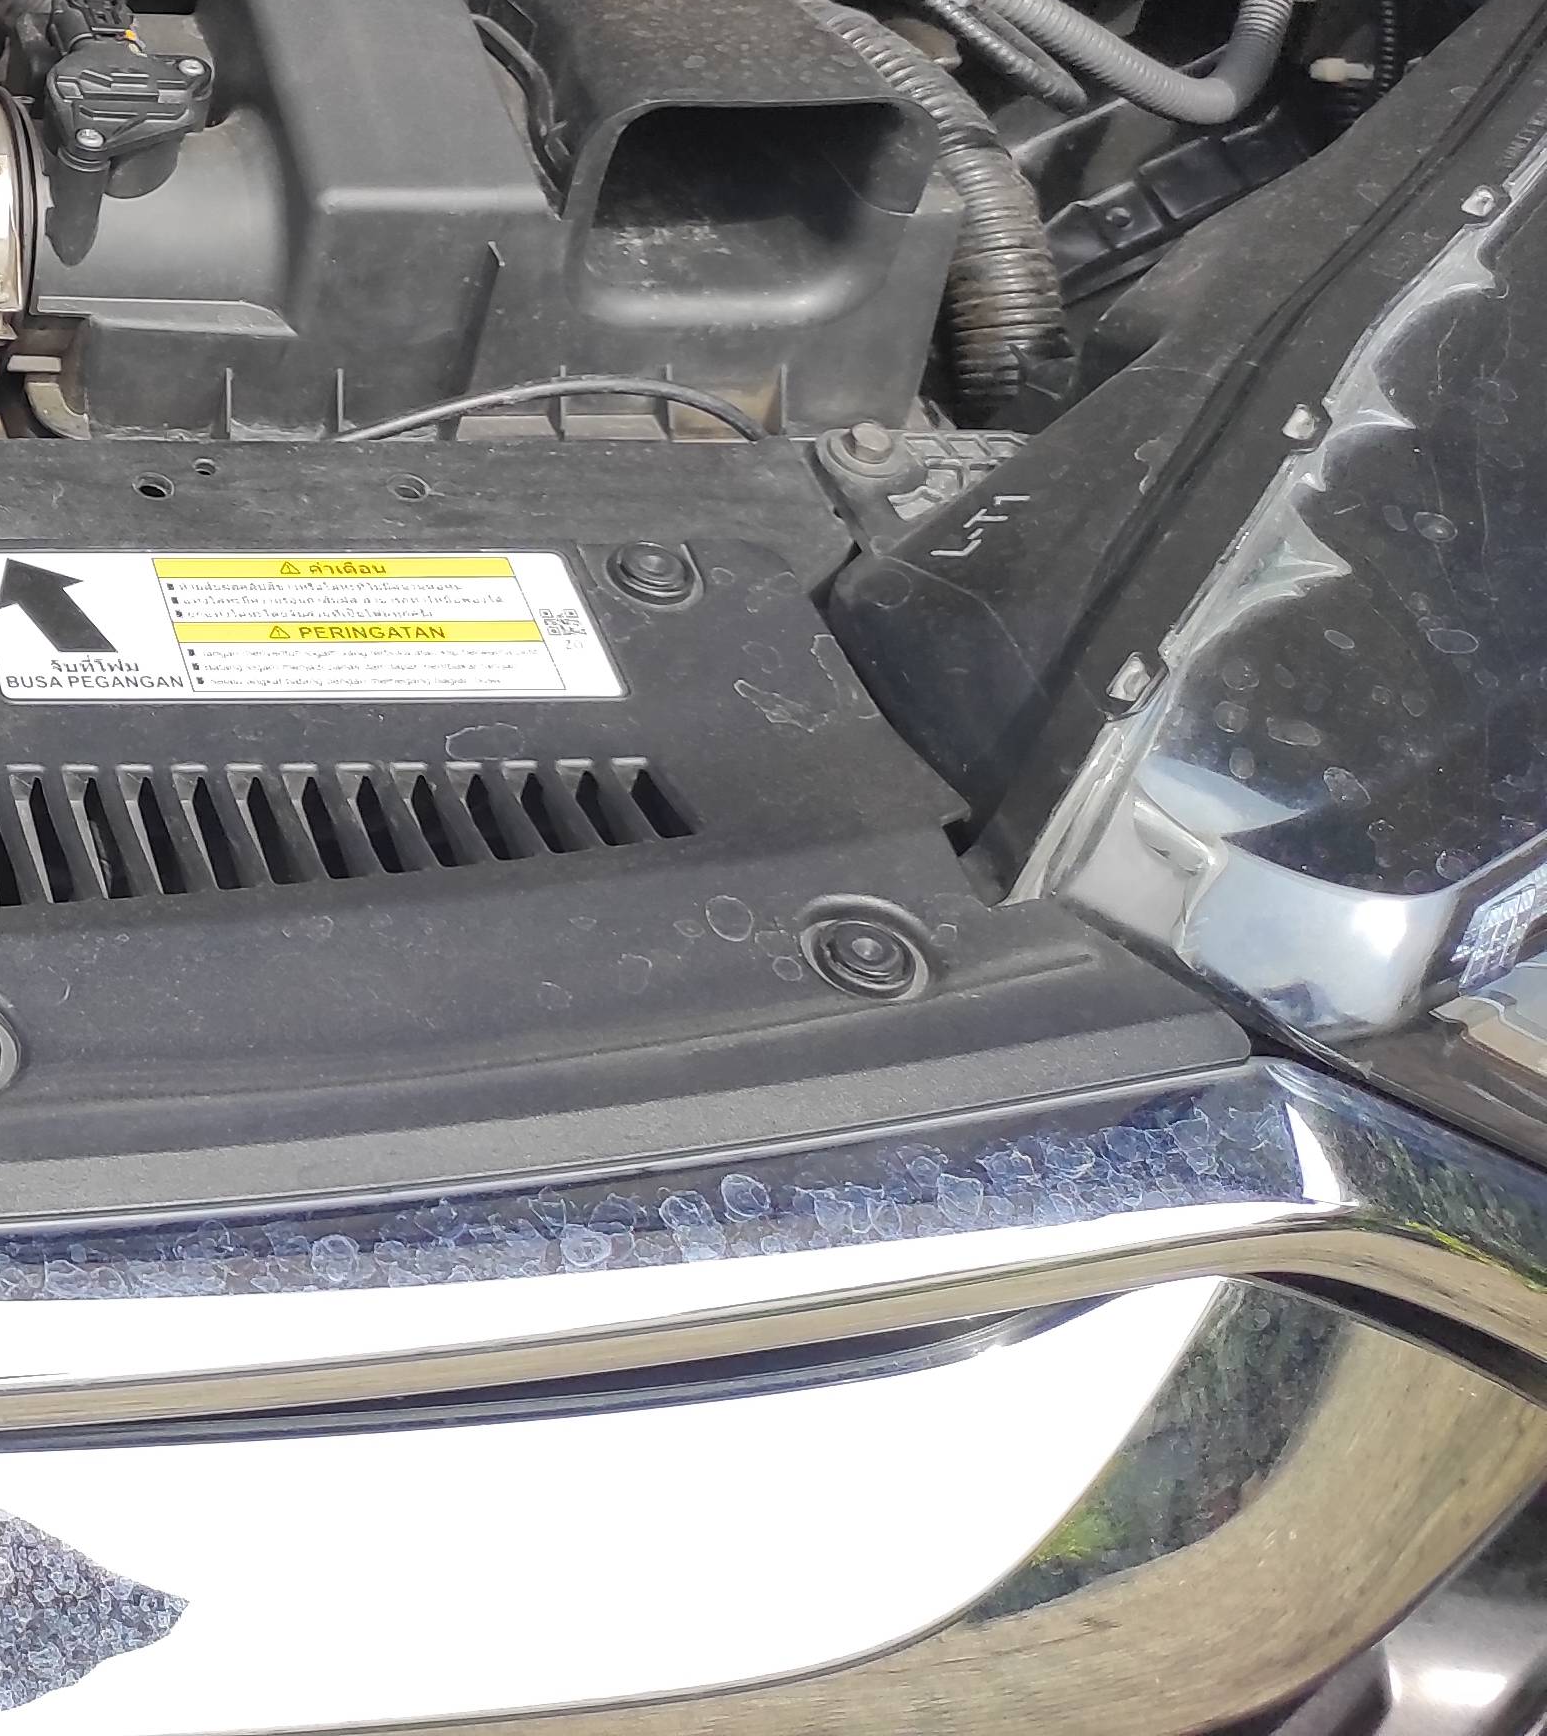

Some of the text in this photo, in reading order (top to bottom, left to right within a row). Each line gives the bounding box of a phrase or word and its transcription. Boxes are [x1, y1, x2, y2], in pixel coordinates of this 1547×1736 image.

[298, 625, 447, 640] PERINGATAN
[5, 675, 185, 689] BUSA PEGANGAN
